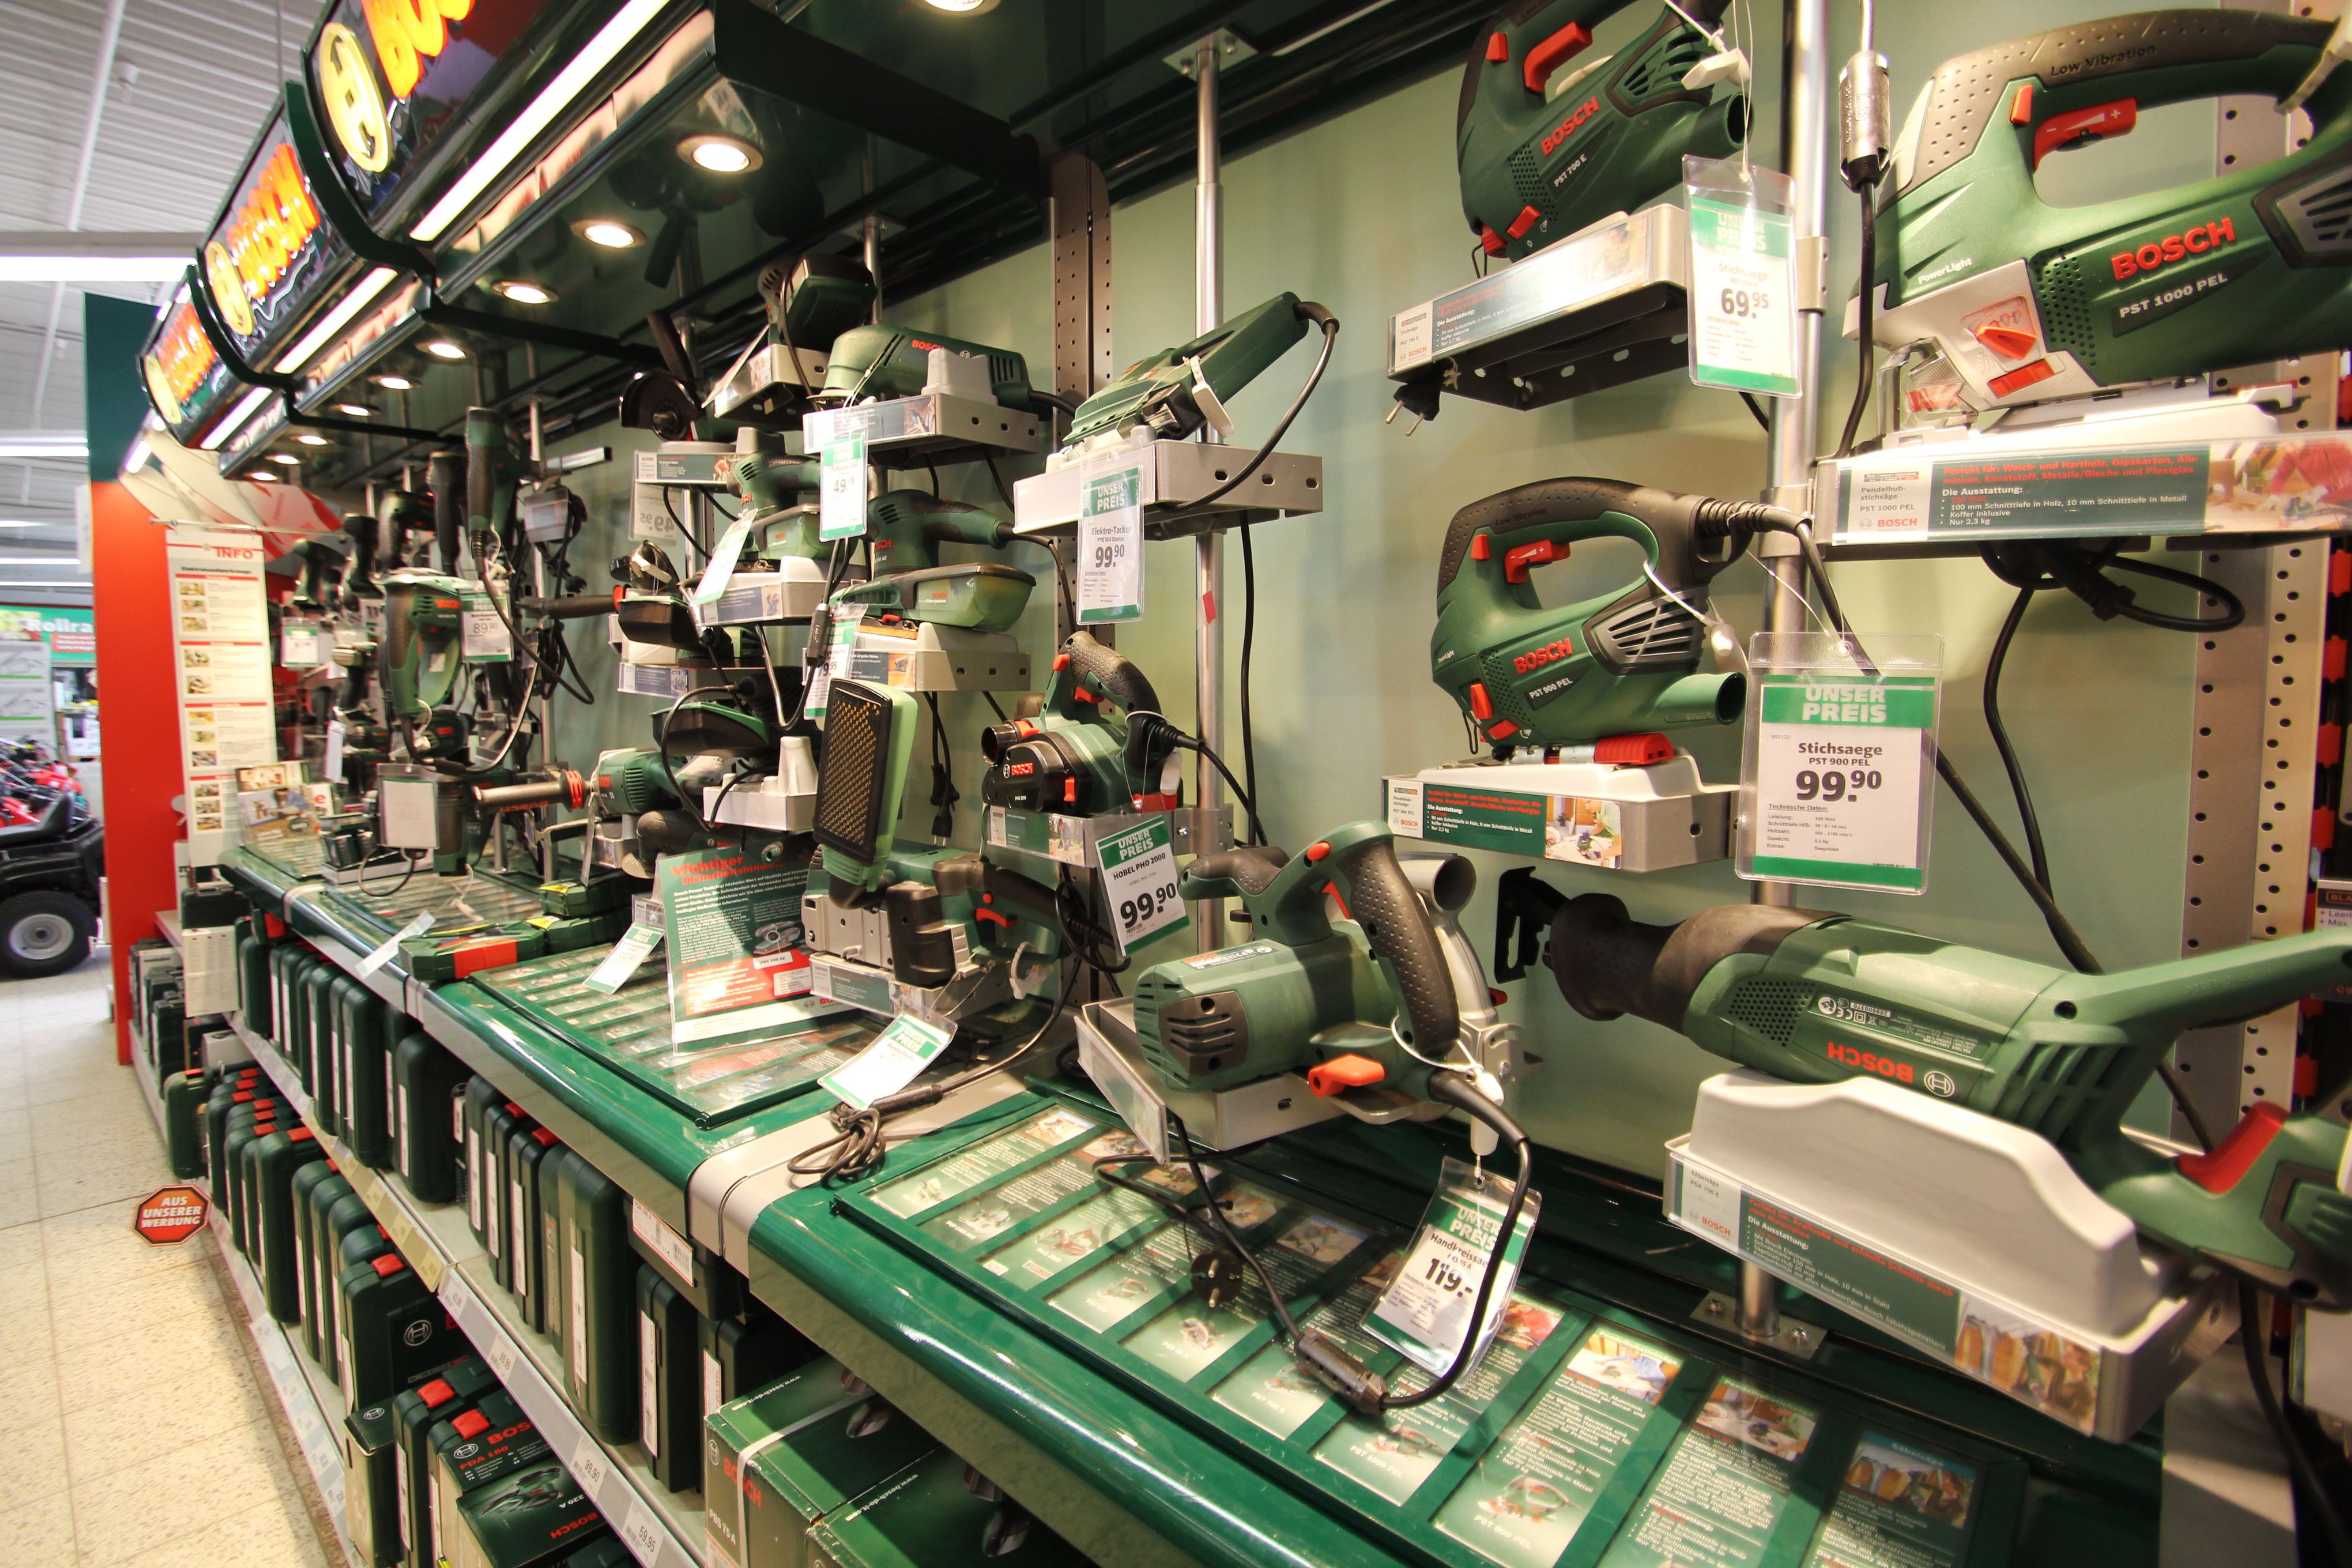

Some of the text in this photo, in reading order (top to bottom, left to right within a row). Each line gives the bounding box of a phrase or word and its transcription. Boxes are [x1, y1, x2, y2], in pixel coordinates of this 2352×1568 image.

[2051, 44, 2157, 78] Low Vibration
[1541, 96, 1599, 157] BOSCH
[1553, 154, 1588, 187] PST 700 E
[2111, 216, 2237, 281] BOSCH
[1918, 257, 1974, 285] PowerLight
[2119, 273, 2228, 318] PST 1000 PEL
[1446, 308, 1475, 325] Ausstattung:
[1408, 346, 1427, 357] BOSCH
[1944, 466, 1980, 475] Perfekt
[2003, 461, 2036, 472] Weich-
[2040, 462, 2059, 470] und
[2062, 459, 2108, 470] Hartholz,
[2112, 457, 2174, 467] Gipskarton,
[1097, 480, 1124, 498] UNSER
[1861, 485, 1906, 493] Pendelhub-
[1961, 487, 2023, 497] Ausstattung:
[1097, 493, 1125, 512] PREIS
[2043, 500, 2064, 508] Holz,
[2160, 495, 2187, 503] Metall
[1092, 525, 1132, 536] Elektro-Tacker
[1878, 518, 1917, 527] BOSCH
[1981, 517, 1991, 525] kg
[216, 547, 253, 559] INFO
[1095, 544, 1125, 568] 99.90
[26, 617, 94, 632] Rollra
[1514, 637, 1573, 674] BOSCH
[1529, 677, 1573, 699] PST 900 PEL
[1805, 685, 1886, 703] UNSER
[1802, 702, 1887, 723] PREIS
[1798, 742, 1883, 759] Stichsaege
[1809, 757, 1871, 767] PST 900 PEL
[1011, 762, 1034, 776] BOSCH
[1795, 770, 1882, 802] 99.90
[1435, 805, 1463, 815] Ausstattung:
[1117, 827, 1151, 849] UNSER
[1120, 838, 1154, 861] PREIS
[670, 856, 745, 877] Wichtiger
[1113, 852, 1166, 881] HOBEL PHO 2000
[1120, 882, 1177, 930] 99.90
[1827, 1041, 1914, 1083] BOSCH
[142, 1206, 202, 1218] UNSERER
[161, 1196, 188, 1207] AUS
[141, 1216, 201, 1228] WERBUNG
[1456, 1206, 1503, 1237] UNSER
[1702, 1216, 1731, 1237] BOSCH
[1748, 1215, 1760, 1226] Die
[1762, 1222, 1810, 1251] Ausstattung:
[1449, 1218, 1497, 1253] PREIS
[1765, 1237, 1782, 1251] Bosch
[1431, 1233, 1489, 1268] Handkreissae
[1805, 1264, 1816, 1274] mm
[1852, 1287, 1863, 1297] mm
[1873, 1296, 1890, 1310] Stahl
[1599, 1330, 1678, 1365] Pendelhubstichsäge
[732, 1375, 801, 1411] www.bosch-do-it.com
[487, 1420, 533, 1446] BOS
[459, 1456, 486, 1471] PDA
[487, 1445, 510, 1460] 180
[1350, 1445, 1367, 1458] PST
[584, 1458, 600, 1484] 99,90
[723, 1457, 762, 1508] BOCH
[845, 1473, 919, 1522] www.bosch-do-it.com
[550, 1511, 598, 1540] BOSCH
[708, 1508, 722, 1531] PBS
[723, 1522, 731, 1538] 75
[1473, 1514, 1495, 1529] PST
[1511, 1534, 1531, 1550] PEL
[638, 1524, 656, 1553] 59,95
